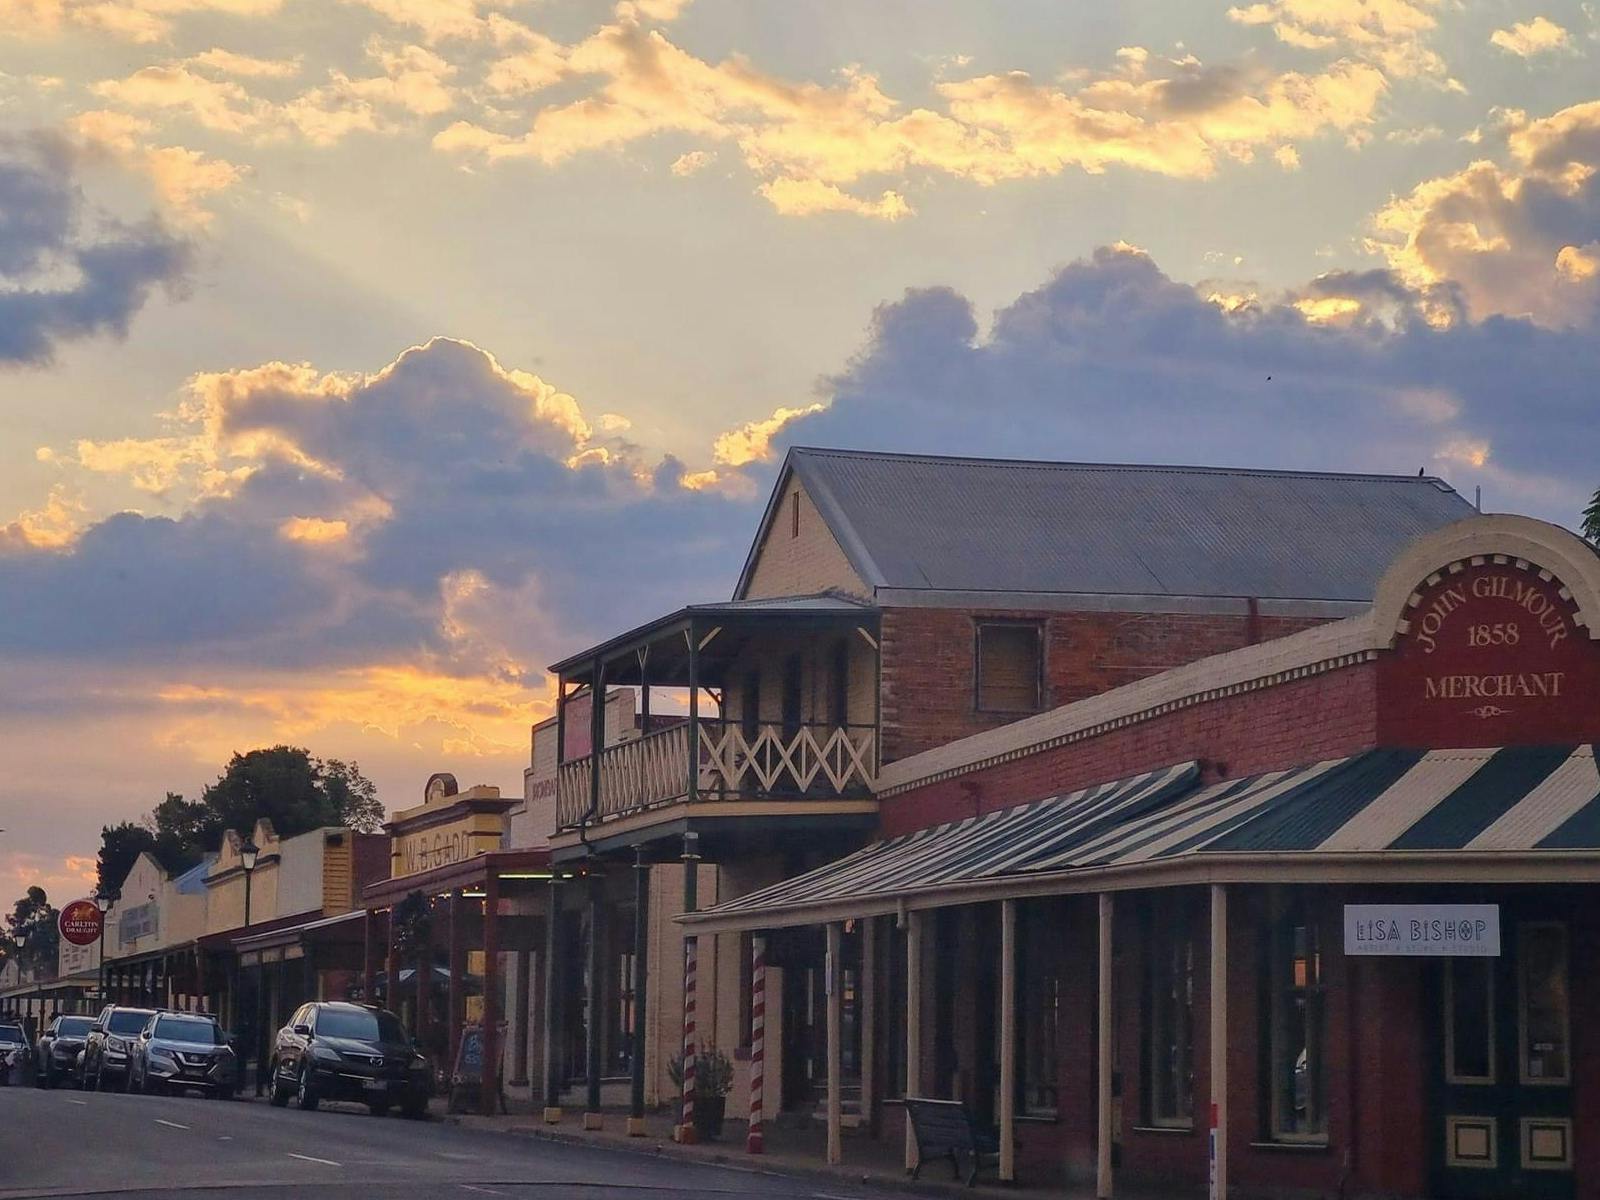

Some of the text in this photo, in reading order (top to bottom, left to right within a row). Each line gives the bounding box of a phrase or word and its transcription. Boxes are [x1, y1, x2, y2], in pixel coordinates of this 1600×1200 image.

[1416, 576, 1568, 653] JOHN GILMOUR
[1467, 622, 1520, 647] 1858
[1425, 672, 1565, 698] MERCHANT
[1356, 919, 1486, 941] LISA BISHOP
